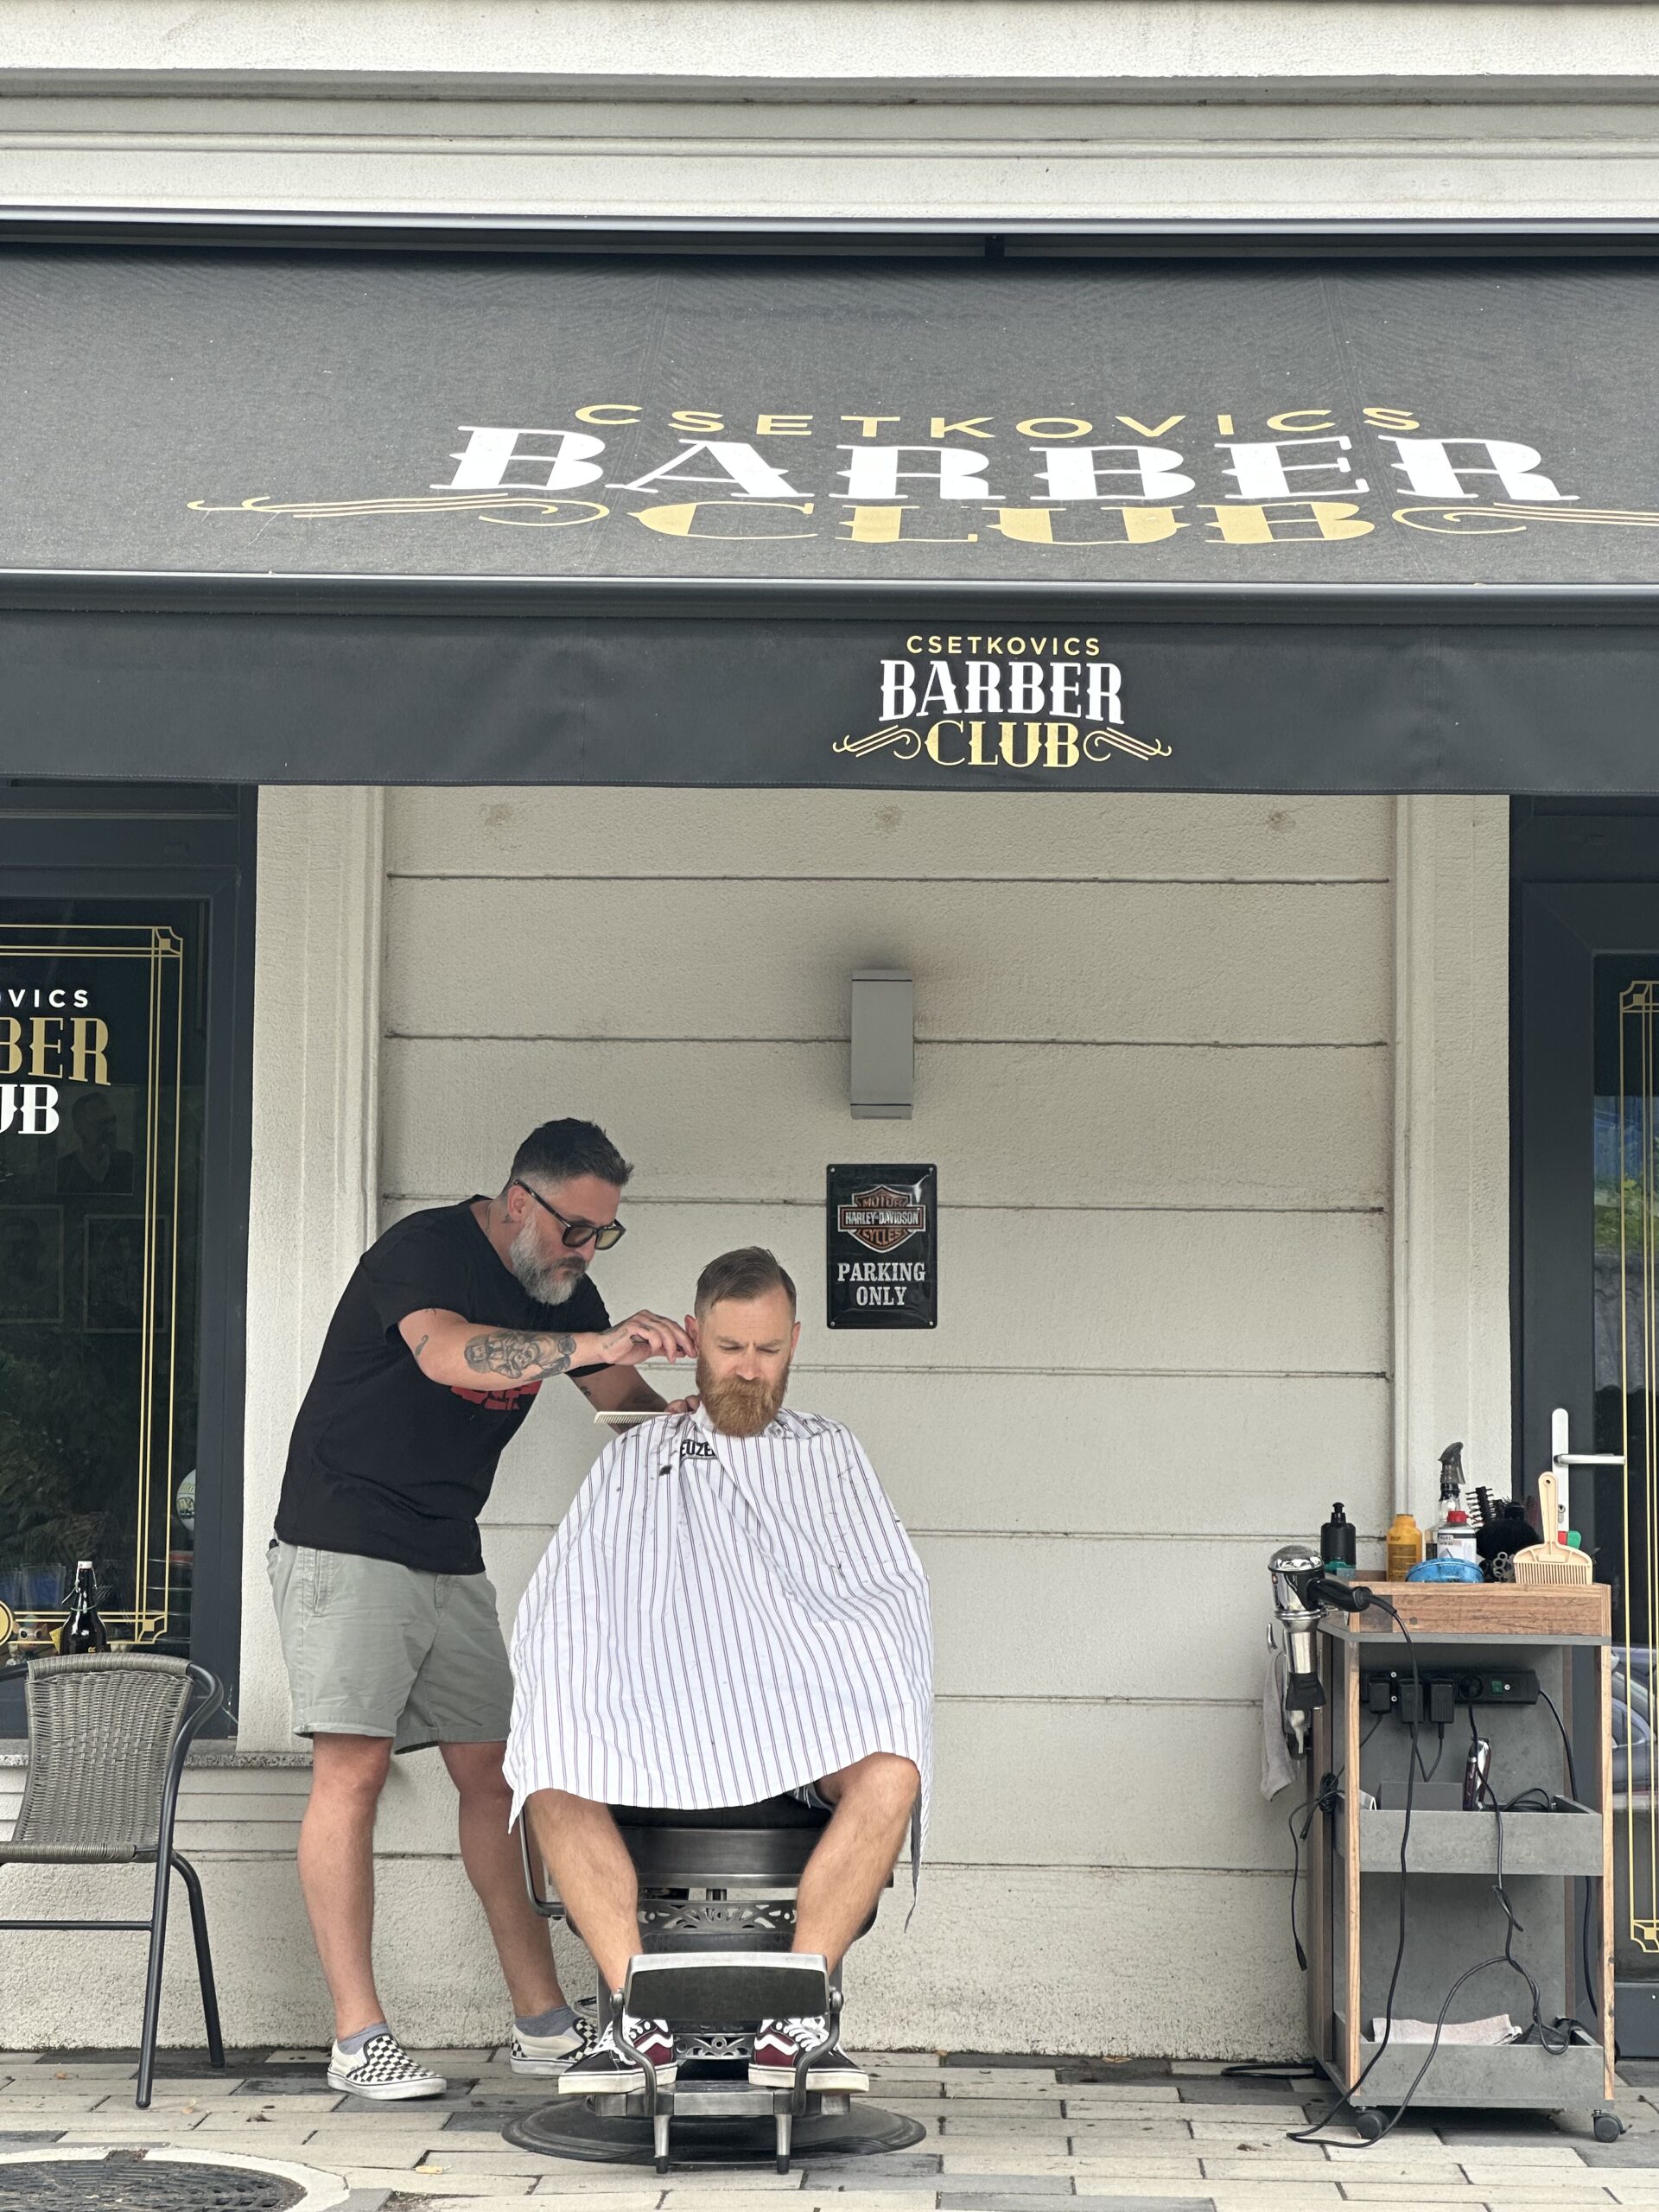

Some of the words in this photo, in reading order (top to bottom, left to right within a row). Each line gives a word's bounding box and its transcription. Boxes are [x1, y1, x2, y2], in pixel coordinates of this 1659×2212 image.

[575, 404, 1420, 438] CSETKOVICS
[429, 425, 1580, 502] BARBER
[627, 501, 1376, 544] CLUB
[906, 634, 1100, 656] CSETKOVICS
[878, 659, 1125, 725] BARBER
[924, 720, 1080, 768] CLUB
[0, 988, 89, 1009] VICS
[862, 1195, 904, 1208] MOTOR
[844, 1211, 919, 1225] HARLEY-DAVIDSON
[862, 1228, 902, 1245] CYCLES
[837, 1262, 926, 1282] PARKING
[856, 1286, 907, 1306] ONLY
